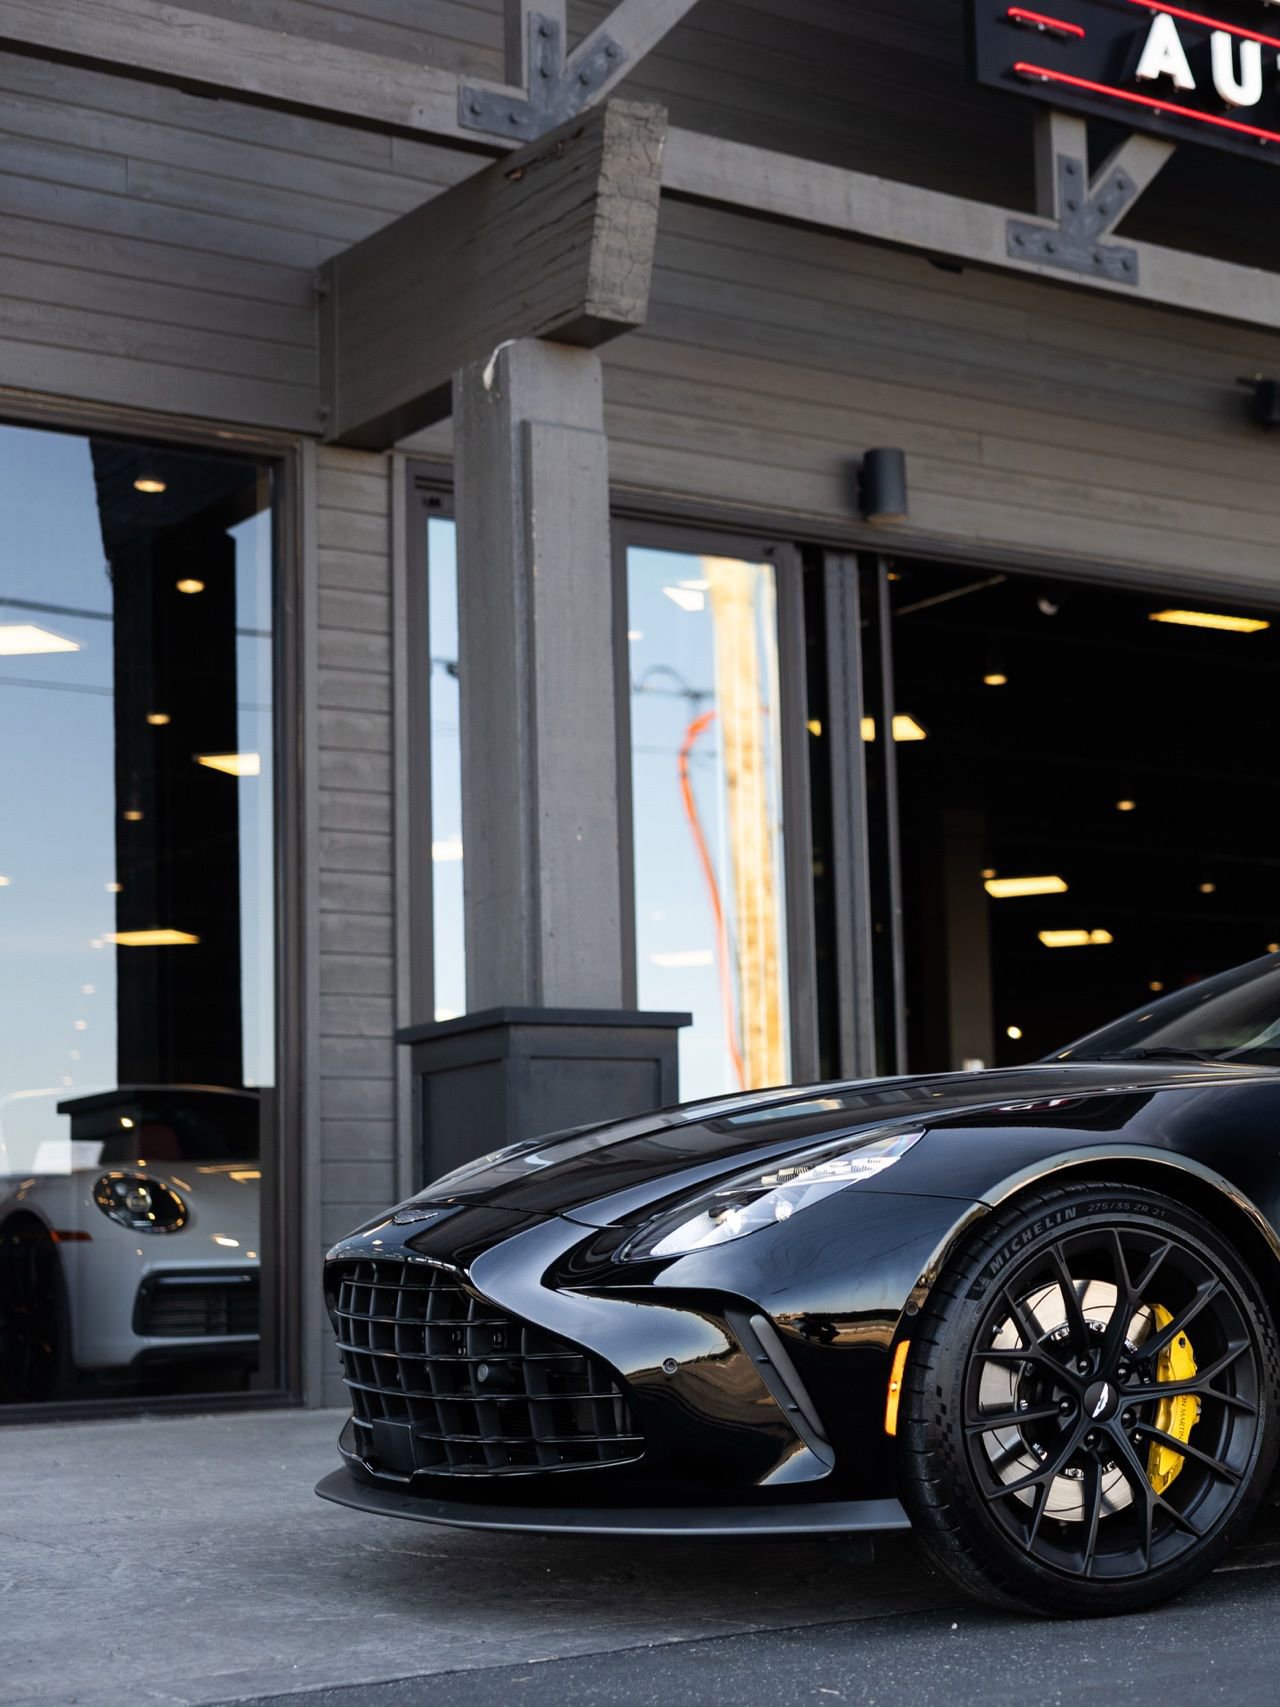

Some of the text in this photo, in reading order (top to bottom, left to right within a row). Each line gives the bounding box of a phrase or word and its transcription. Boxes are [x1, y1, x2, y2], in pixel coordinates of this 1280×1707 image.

[989, 1202, 1166, 1274] MICHELIN 275/35 ZR 21
